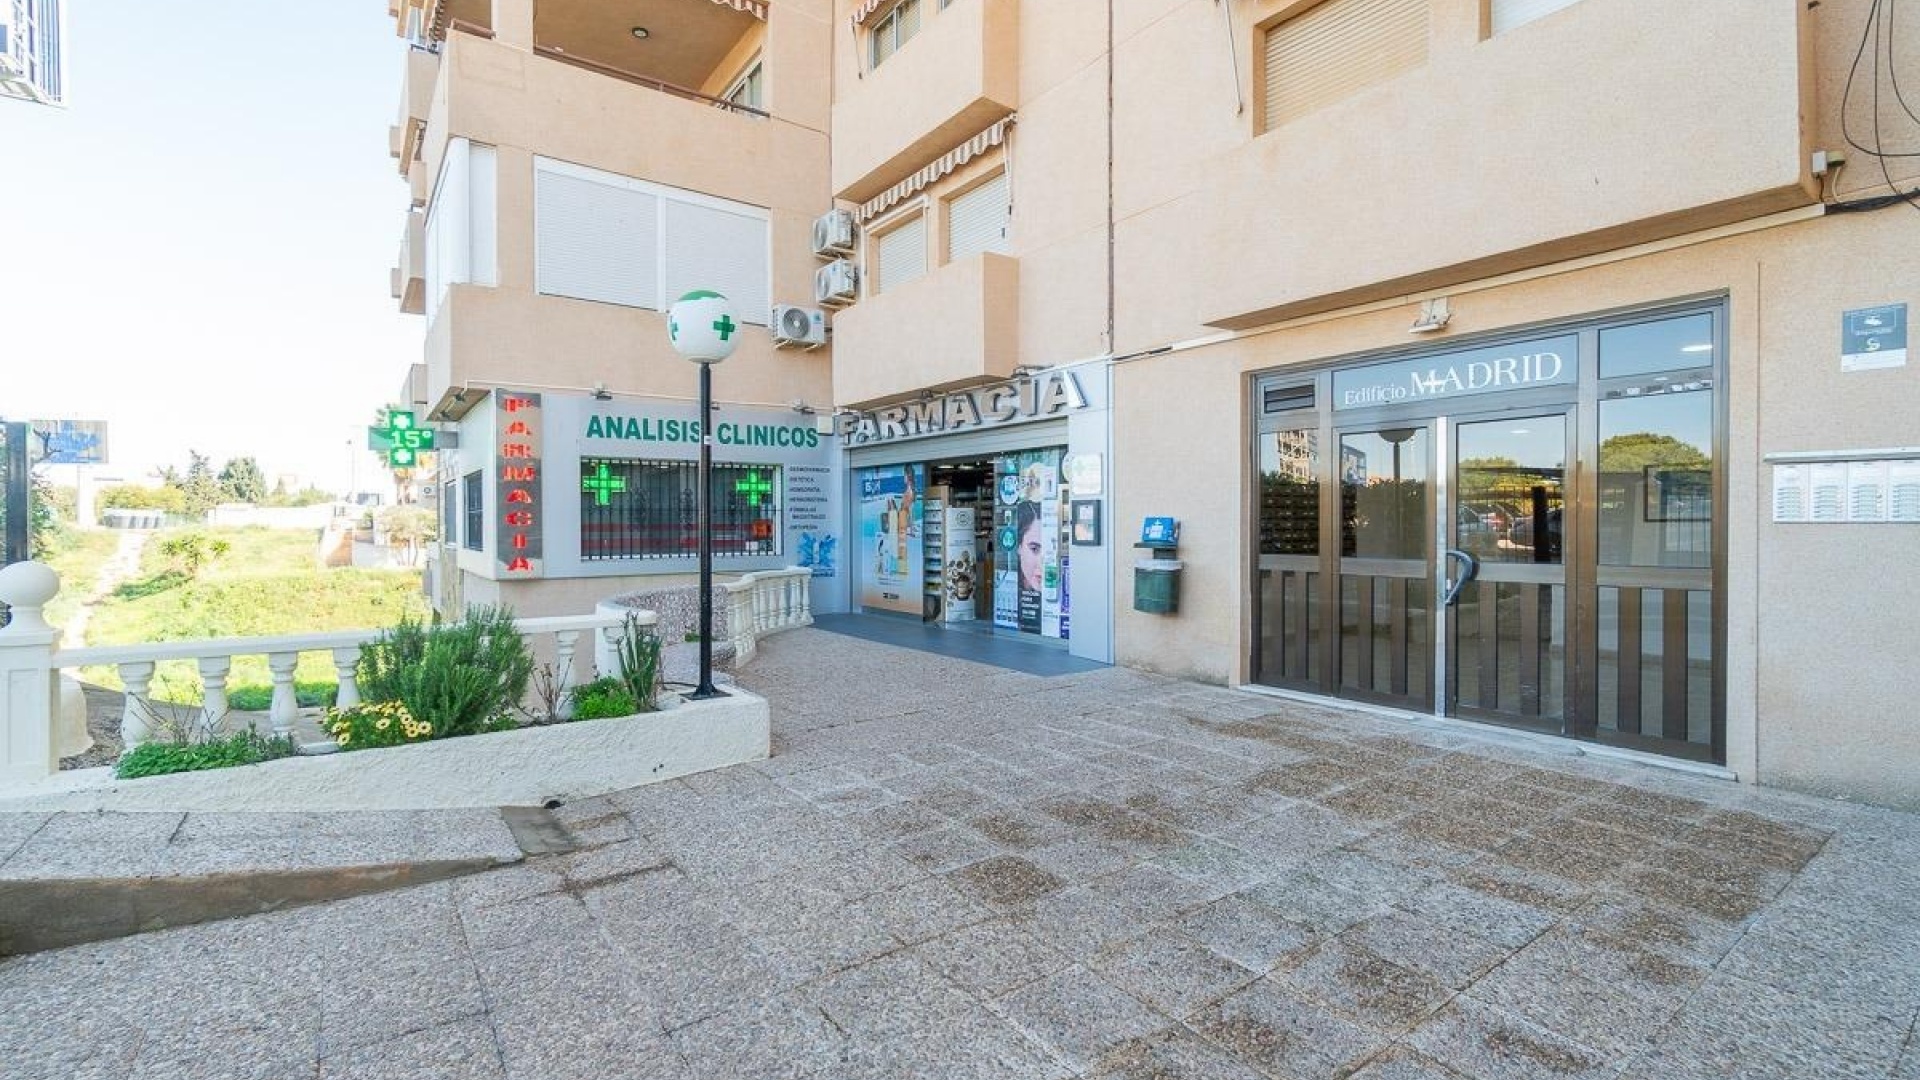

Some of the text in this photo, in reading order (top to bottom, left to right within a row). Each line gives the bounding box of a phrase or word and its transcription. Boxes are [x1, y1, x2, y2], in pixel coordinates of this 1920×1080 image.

[835, 369, 1089, 445] FARMACIA
[1345, 352, 1563, 405] Edificio MADRID
[586, 415, 819, 448] ANALISIS CLINICOS
[503, 396, 536, 572] FARMACIA
